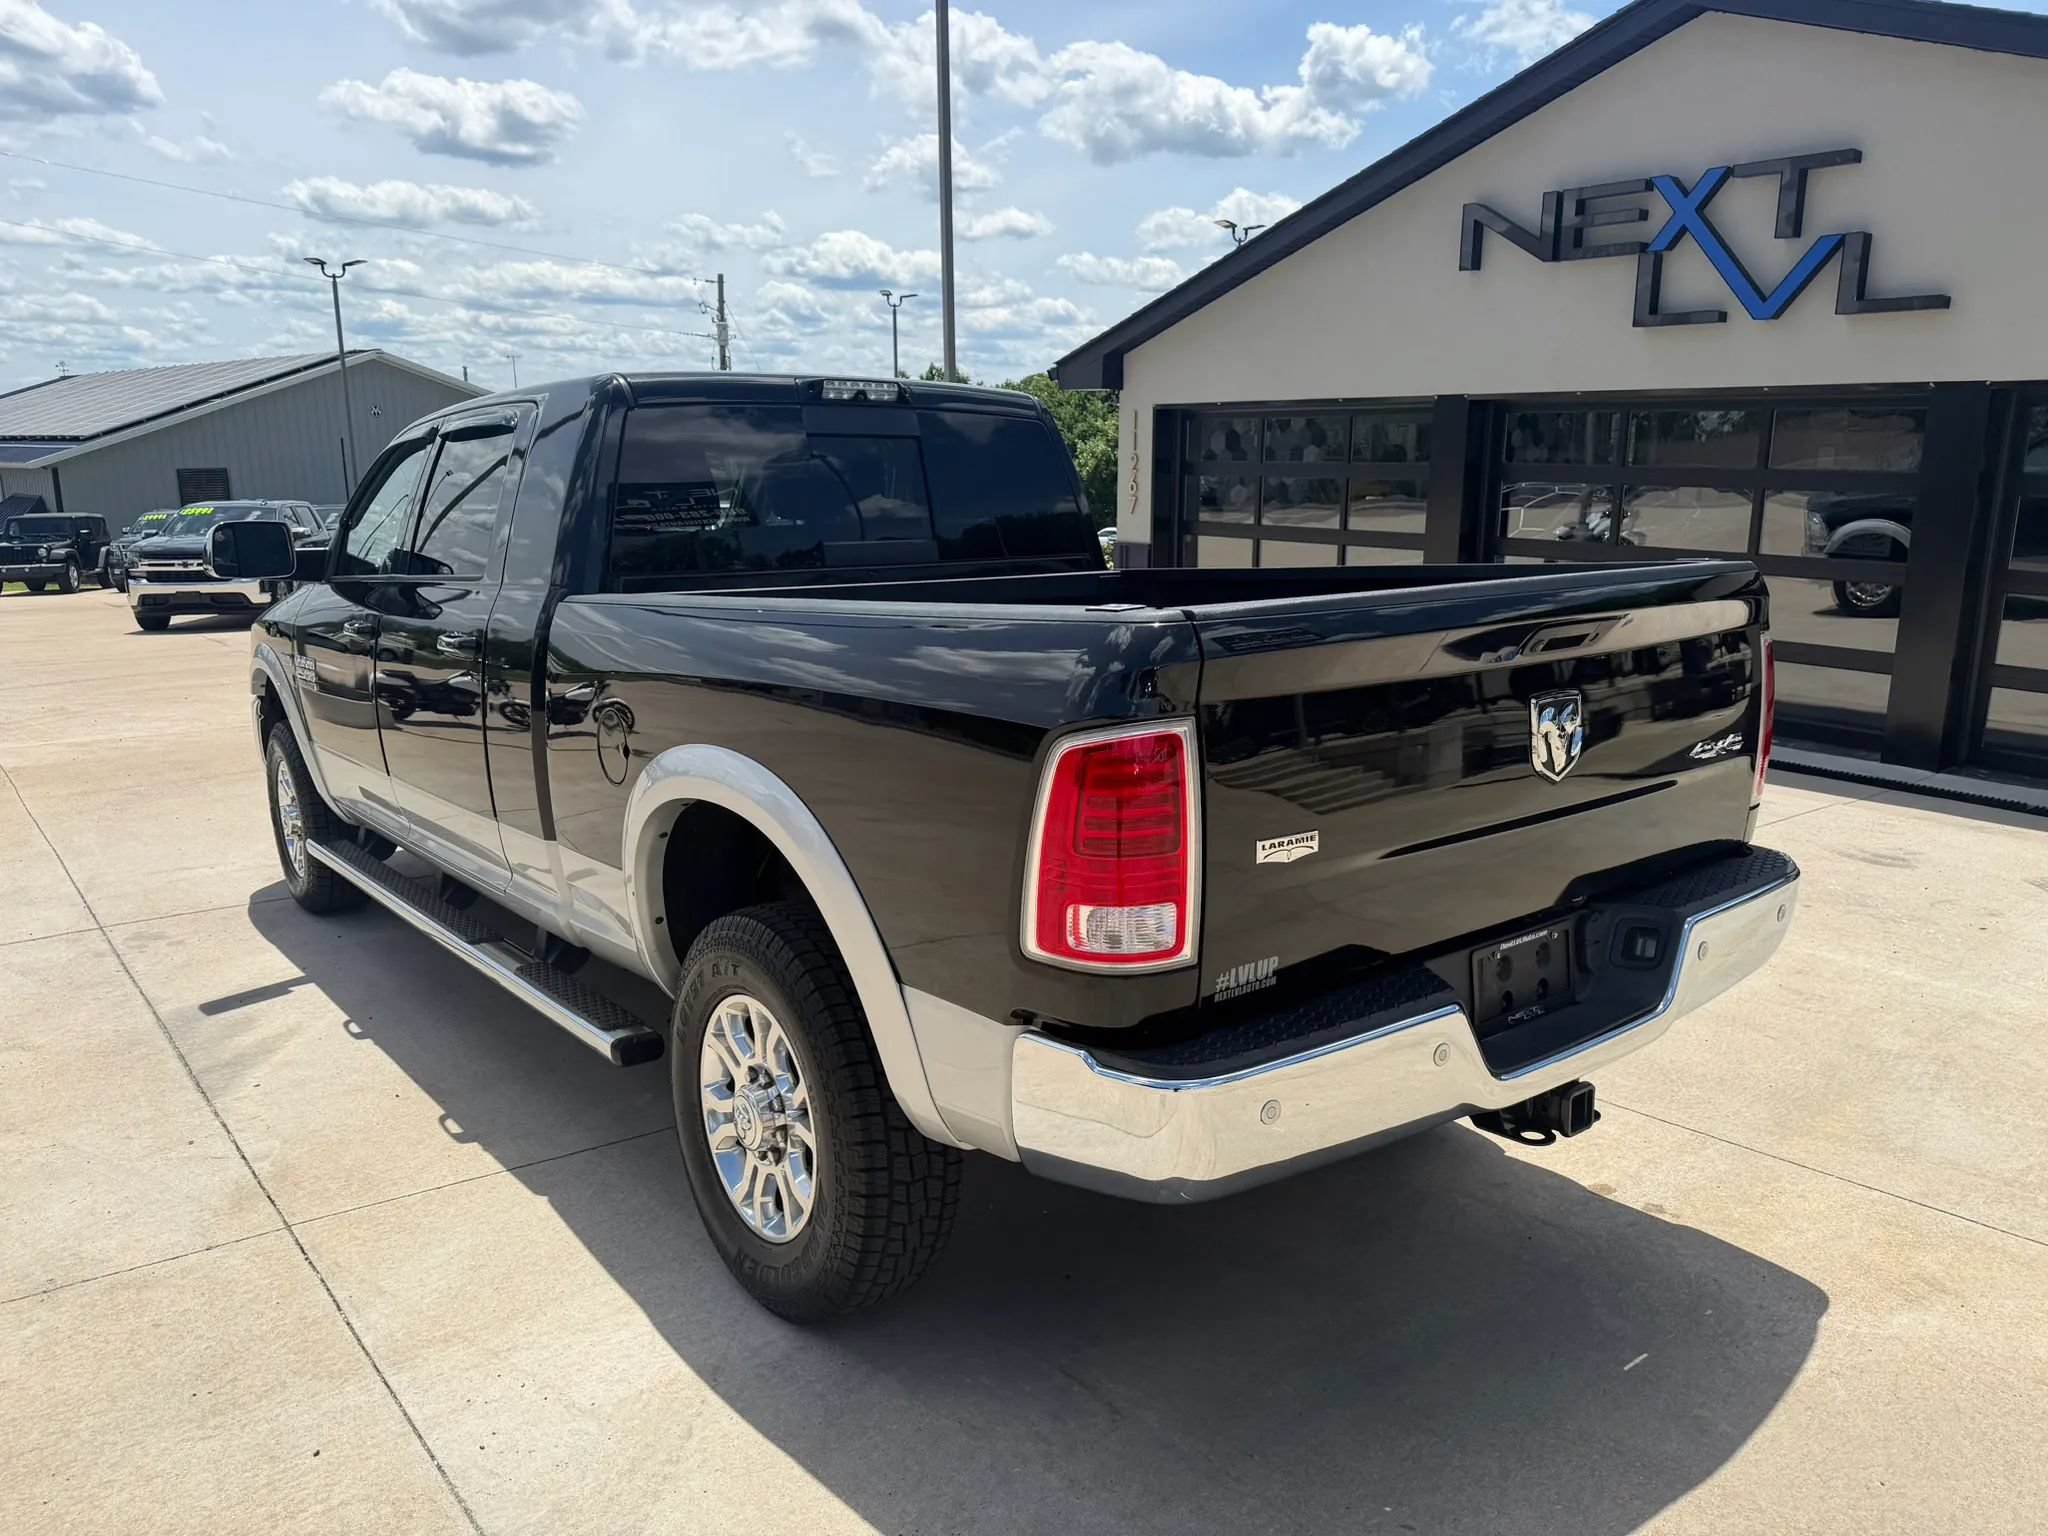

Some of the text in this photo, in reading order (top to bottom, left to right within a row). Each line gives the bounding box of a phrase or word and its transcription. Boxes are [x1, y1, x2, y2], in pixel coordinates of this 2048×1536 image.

[1458, 148, 1862, 272] NEXT
[1632, 230, 1951, 328] LVL
[1129, 410, 1138, 515] 11267
[1261, 834, 1317, 851] LARAMIE
[711, 961, 741, 978] A/T
[1215, 955, 1279, 993] #LVLUP
